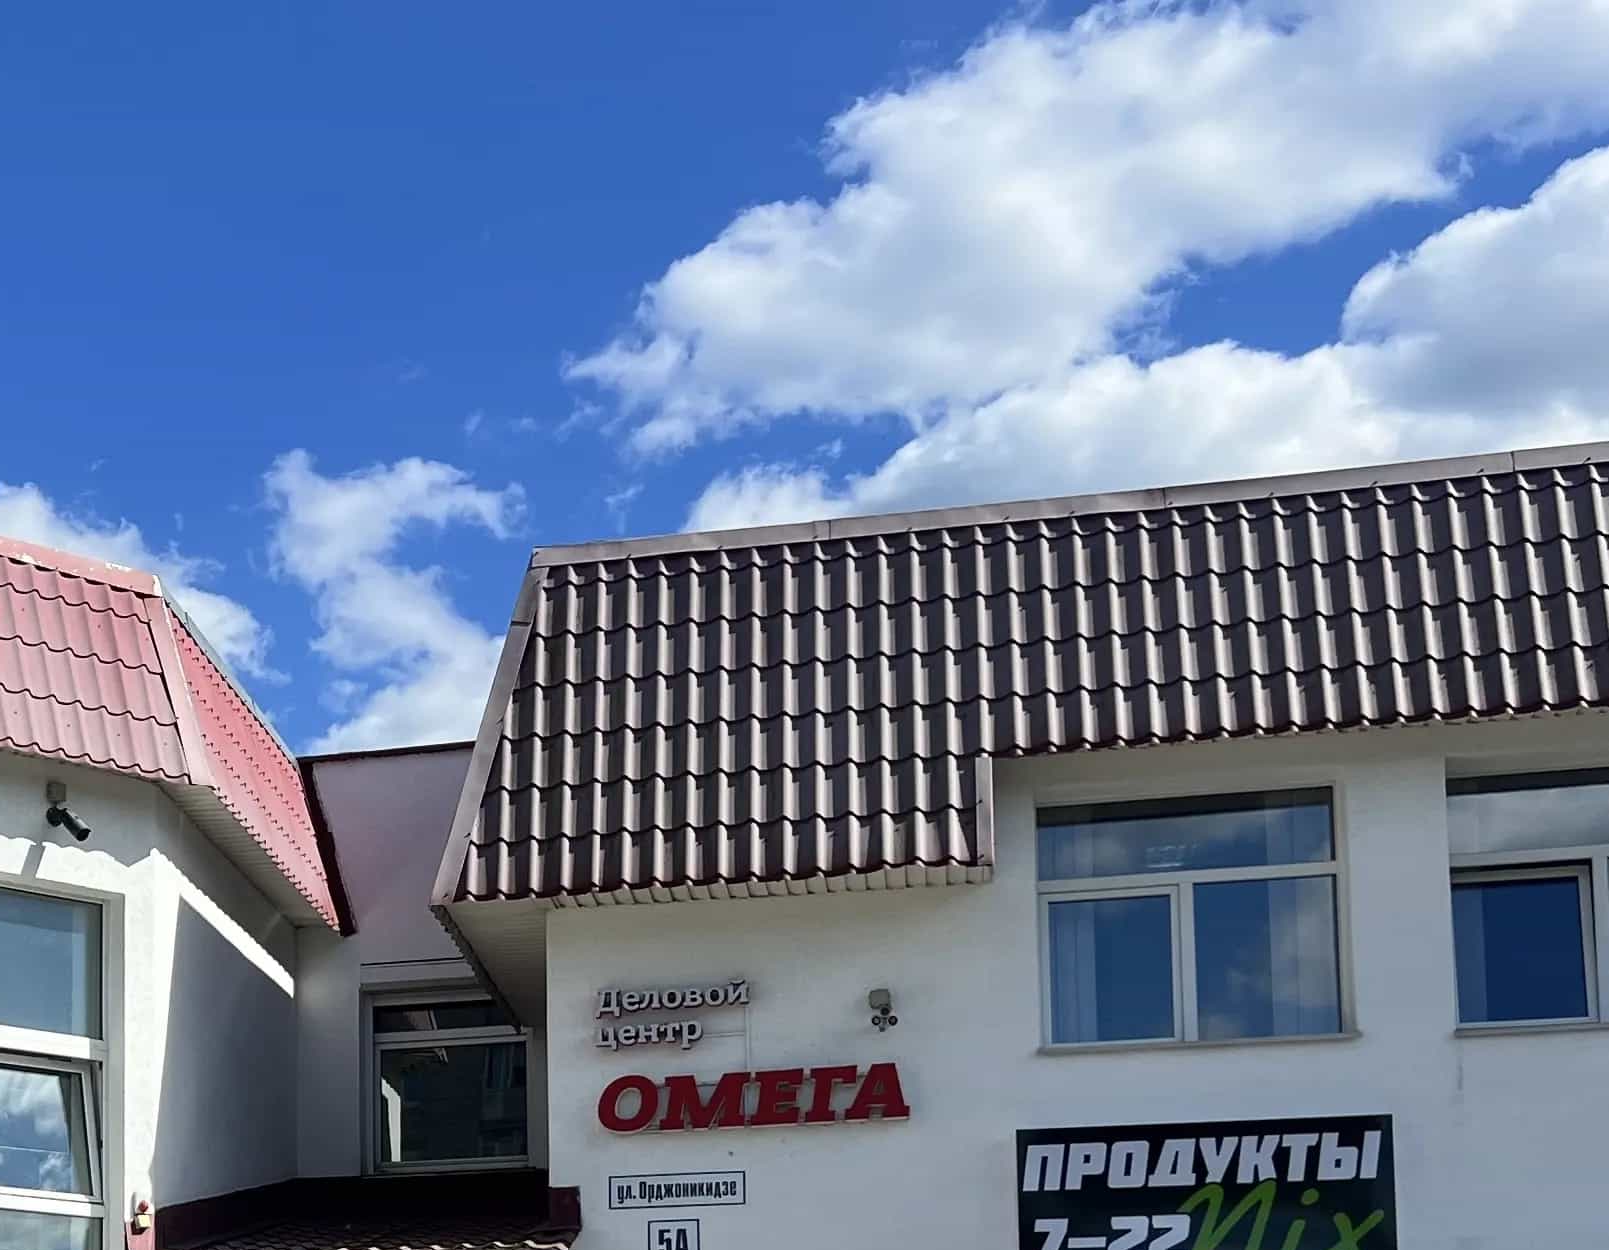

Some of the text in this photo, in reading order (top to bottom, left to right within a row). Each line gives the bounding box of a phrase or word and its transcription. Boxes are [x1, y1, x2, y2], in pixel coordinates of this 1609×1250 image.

[596, 979, 750, 1018] Деловой
[595, 1020, 704, 1051] центр
[597, 1062, 910, 1133] ОМЕГА
[1022, 1130, 1382, 1192] ПРОДУКТЫ
[617, 1180, 737, 1204] ул. Орджоникидзе
